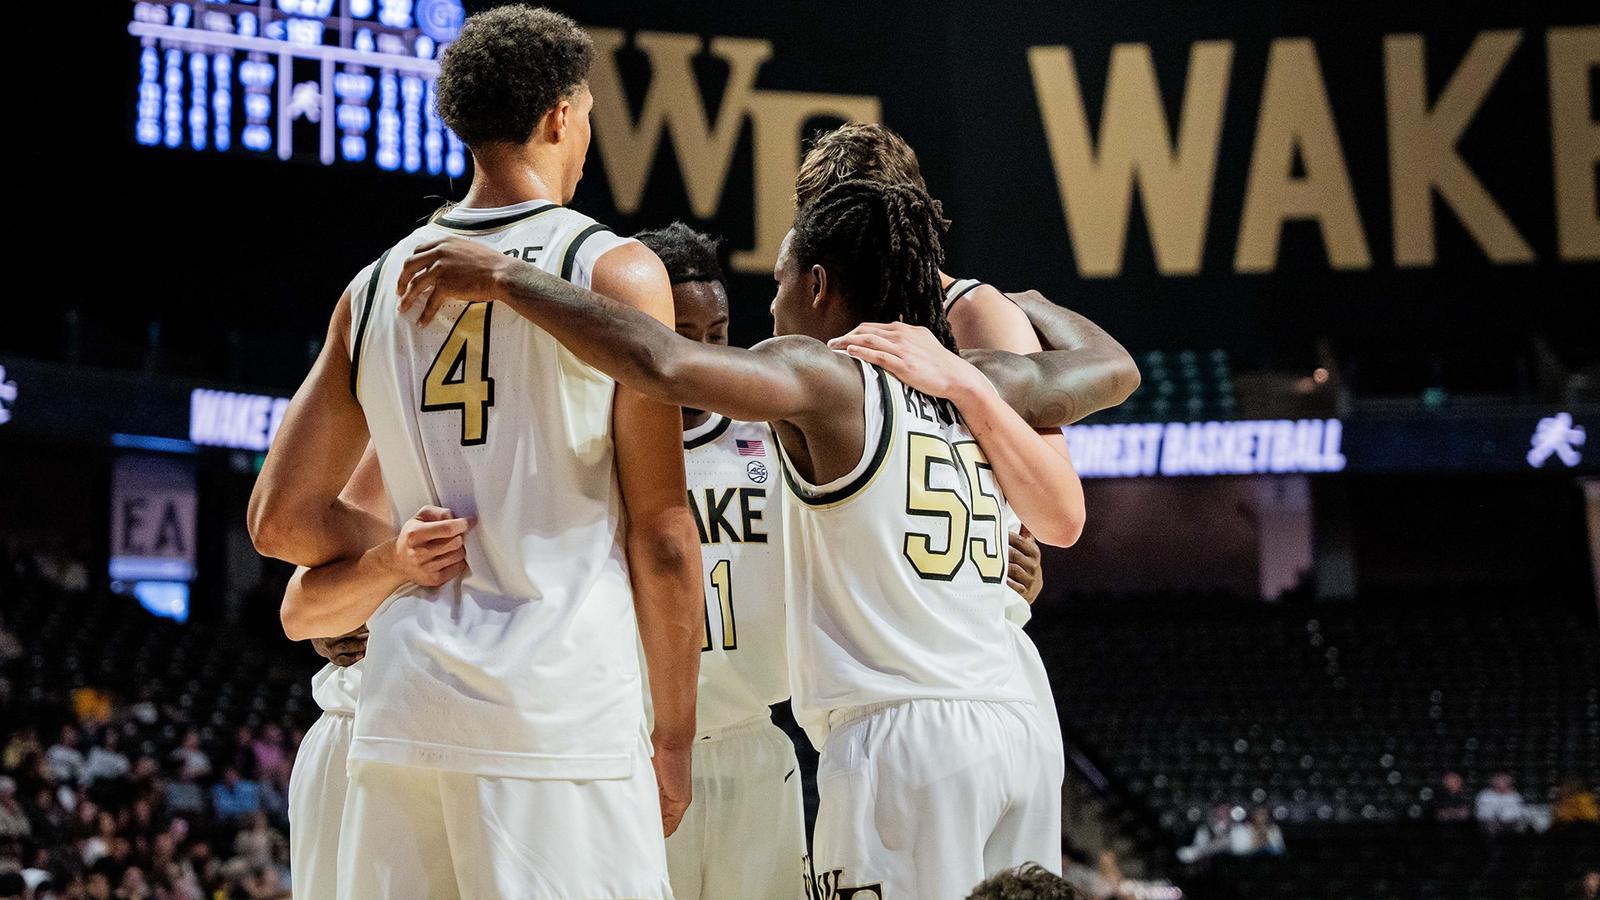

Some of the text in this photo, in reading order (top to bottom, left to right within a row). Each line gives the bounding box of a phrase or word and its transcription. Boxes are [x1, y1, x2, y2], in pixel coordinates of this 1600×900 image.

[421, 301, 494, 446] 4
[903, 431, 1005, 584] 55
[1062, 418, 1346, 478] OREST BASKETBALL
